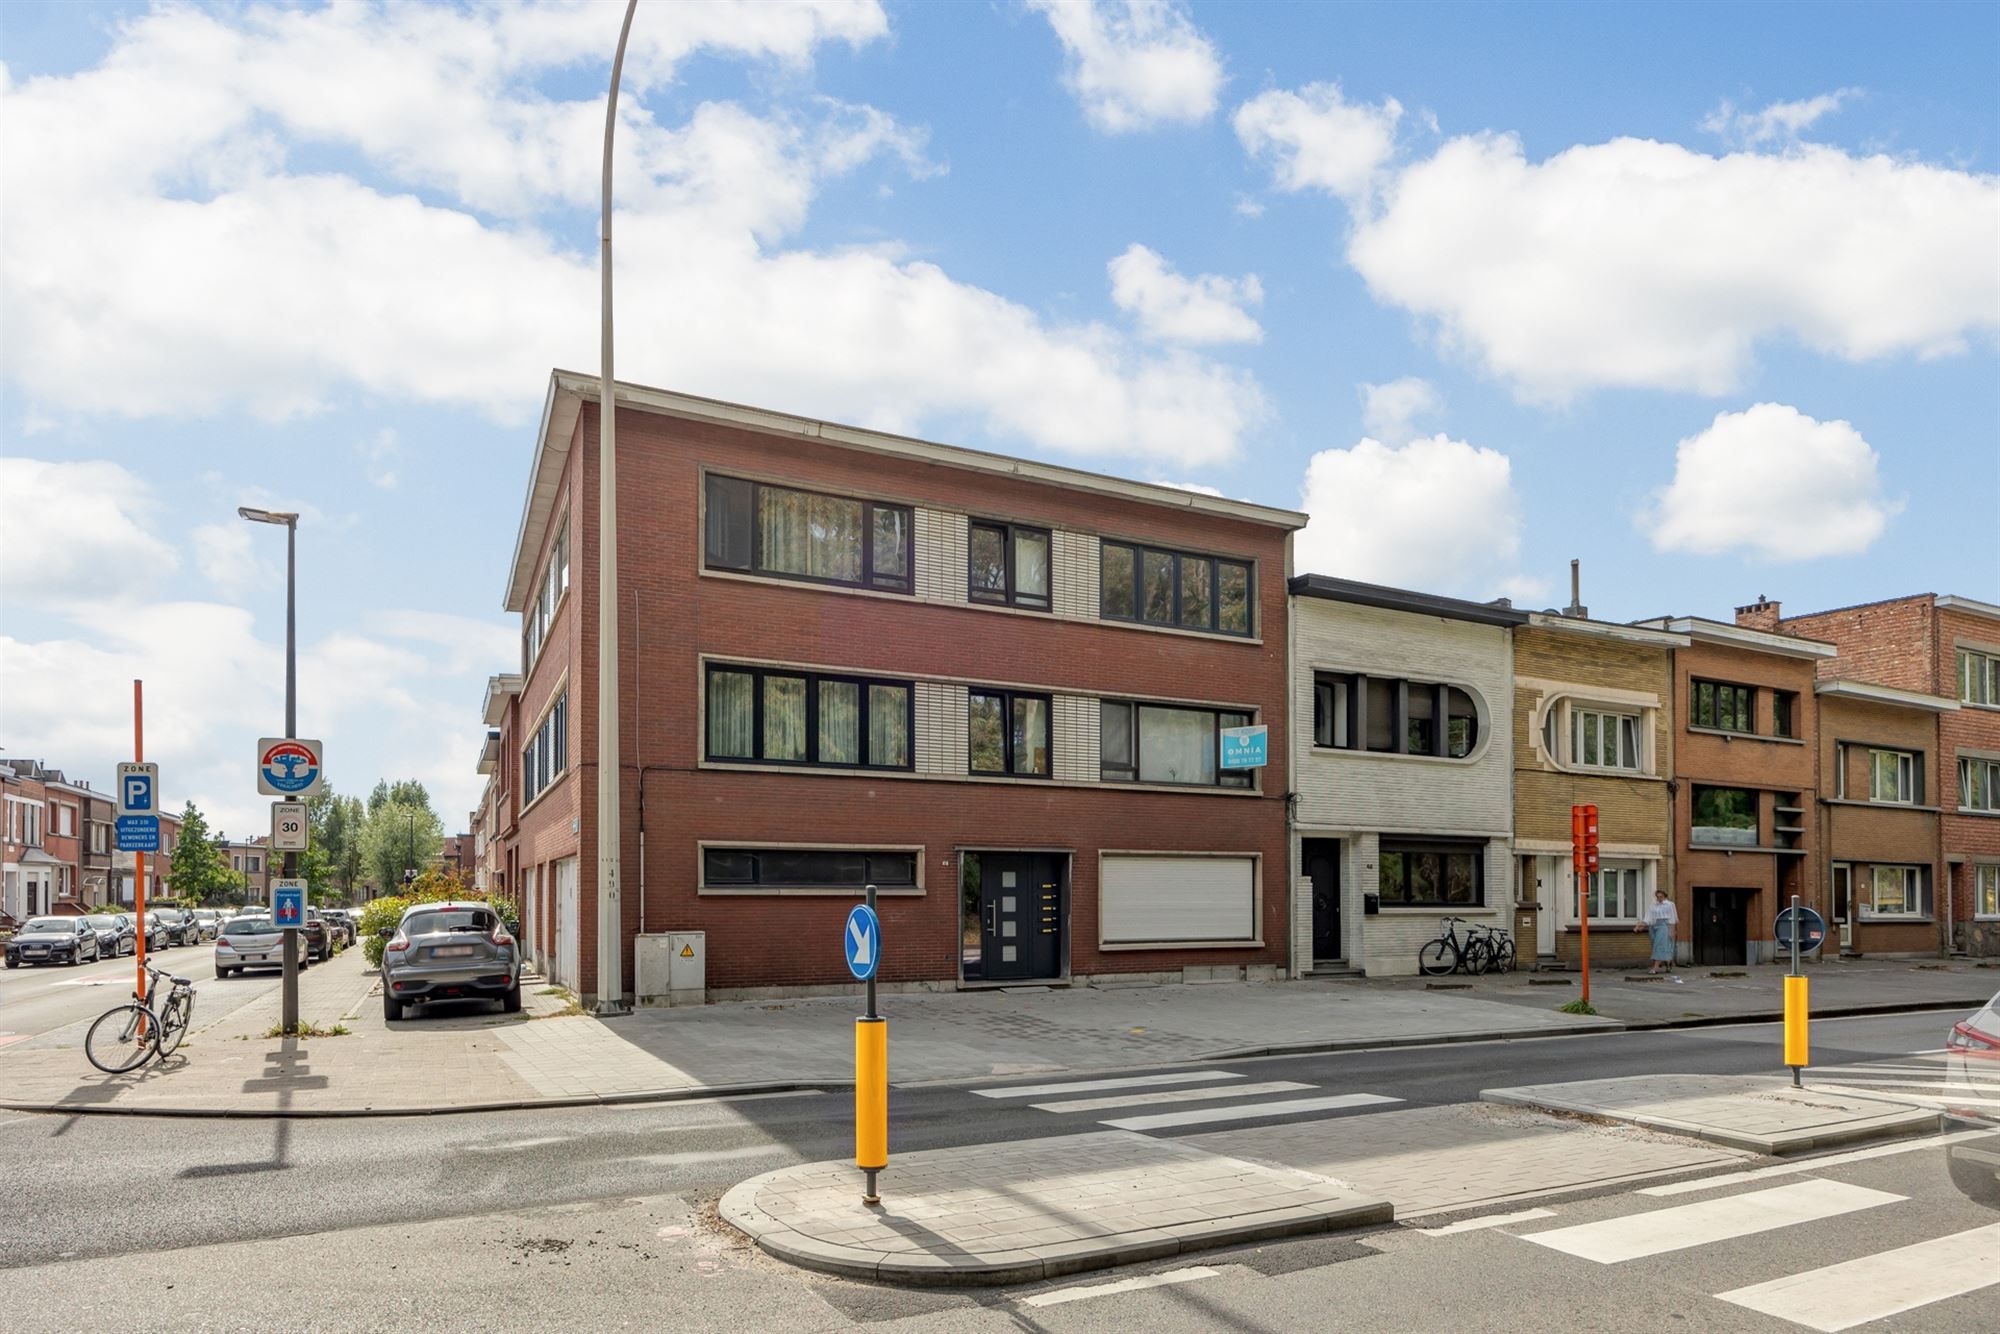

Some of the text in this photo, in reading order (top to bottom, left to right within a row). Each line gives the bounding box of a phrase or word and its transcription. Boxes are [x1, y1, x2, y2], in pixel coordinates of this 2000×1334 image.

[1228, 747, 1261, 755] OMNIA
[128, 781, 147, 805] P
[282, 822, 298, 832] 30
